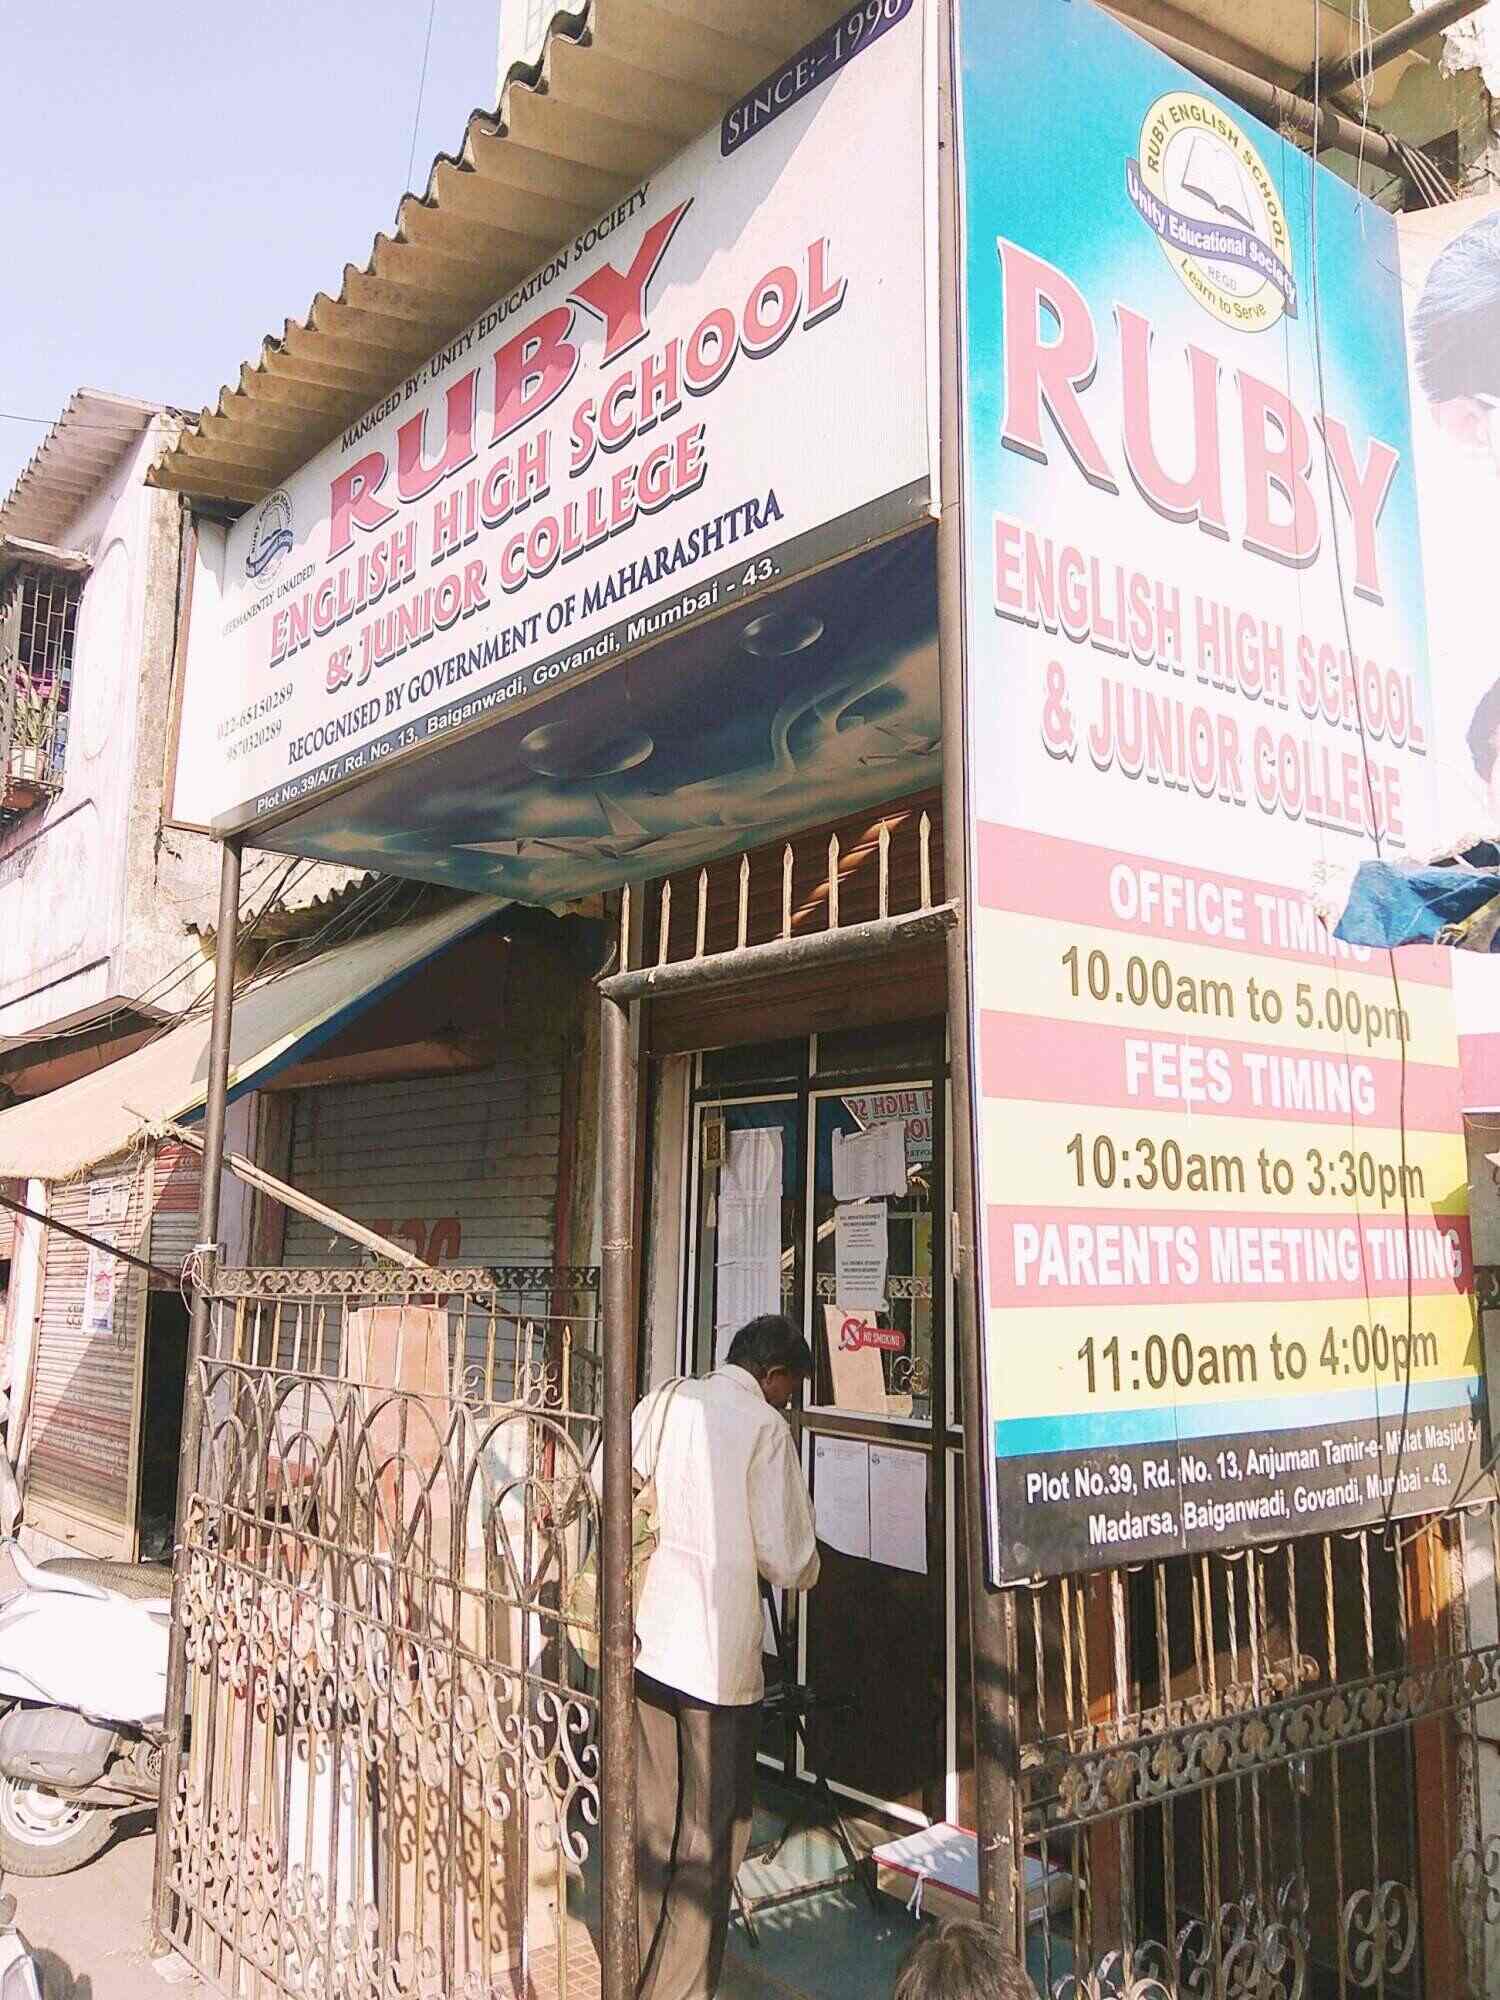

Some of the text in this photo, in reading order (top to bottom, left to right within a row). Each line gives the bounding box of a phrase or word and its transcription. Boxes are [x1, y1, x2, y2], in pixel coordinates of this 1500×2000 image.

[1127, 167, 1297, 304] Unity Educational Society
[1147, 103, 1285, 248] RUBY ENGLISH SCHOOL
[341, 392, 401, 453] MANAGED
[431, 328, 474, 378] UNITY
[477, 251, 569, 341] EDUCATION
[574, 181, 650, 262] SOCIETY
[1181, 258, 1267, 321] Learn to Serve
[326, 197, 695, 564] RUBY
[998, 236, 1400, 607] RUBY
[269, 519, 418, 668] ENGLISH
[430, 429, 552, 566] HIGH
[569, 237, 848, 478] SCHOOL
[288, 488, 784, 765] RECOGNISED BY GOVERNMENT OF MAHARASHTRA
[325, 423, 707, 695] & JUNIOR COLLEGE
[256, 792, 282, 815] Plot
[345, 755, 367, 774] Rd.
[370, 742, 393, 760] No.
[399, 729, 419, 748] 13,
[426, 676, 528, 734] Baiganwadi,
[532, 632, 621, 686] Govandi,
[627, 582, 719, 643] Mumbai
[741, 557, 781, 587] 43.
[994, 519, 1427, 756] ENGLISH HIGH SCHOOL
[1041, 660, 1406, 849] & JUNIOR COLLEGE
[1109, 863, 1373, 963] OFFICE TIMI
[1062, 945, 1411, 1047] 10.00am to 5.00pm
[1124, 1038, 1377, 1116] FEES TIMING
[1066, 1133, 1425, 1210] 10:30am to 3:30pm
[1012, 1223, 1463, 1287] PARENTS MEETING TIMING
[1077, 1324, 1439, 1393] 11:00am to 4:00pm
[1026, 1470, 1070, 1504] Plot
[1074, 1463, 1138, 1498] No.39,
[1142, 1458, 1176, 1490] Rd.
[1180, 1454, 1213, 1485] No.
[1216, 1450, 1243, 1482] 13,
[1246, 1446, 1320, 1480] Anjuman
[1424, 1422, 1465, 1453] Masjid
[1088, 1510, 1178, 1546] Madarsa,
[1183, 1489, 1290, 1532] Baiganwadi,
[1293, 1477, 1363, 1513] Govandi,
[1365, 1466, 1421, 1500] Mumbai
[1431, 1462, 1451, 1487] 43.
